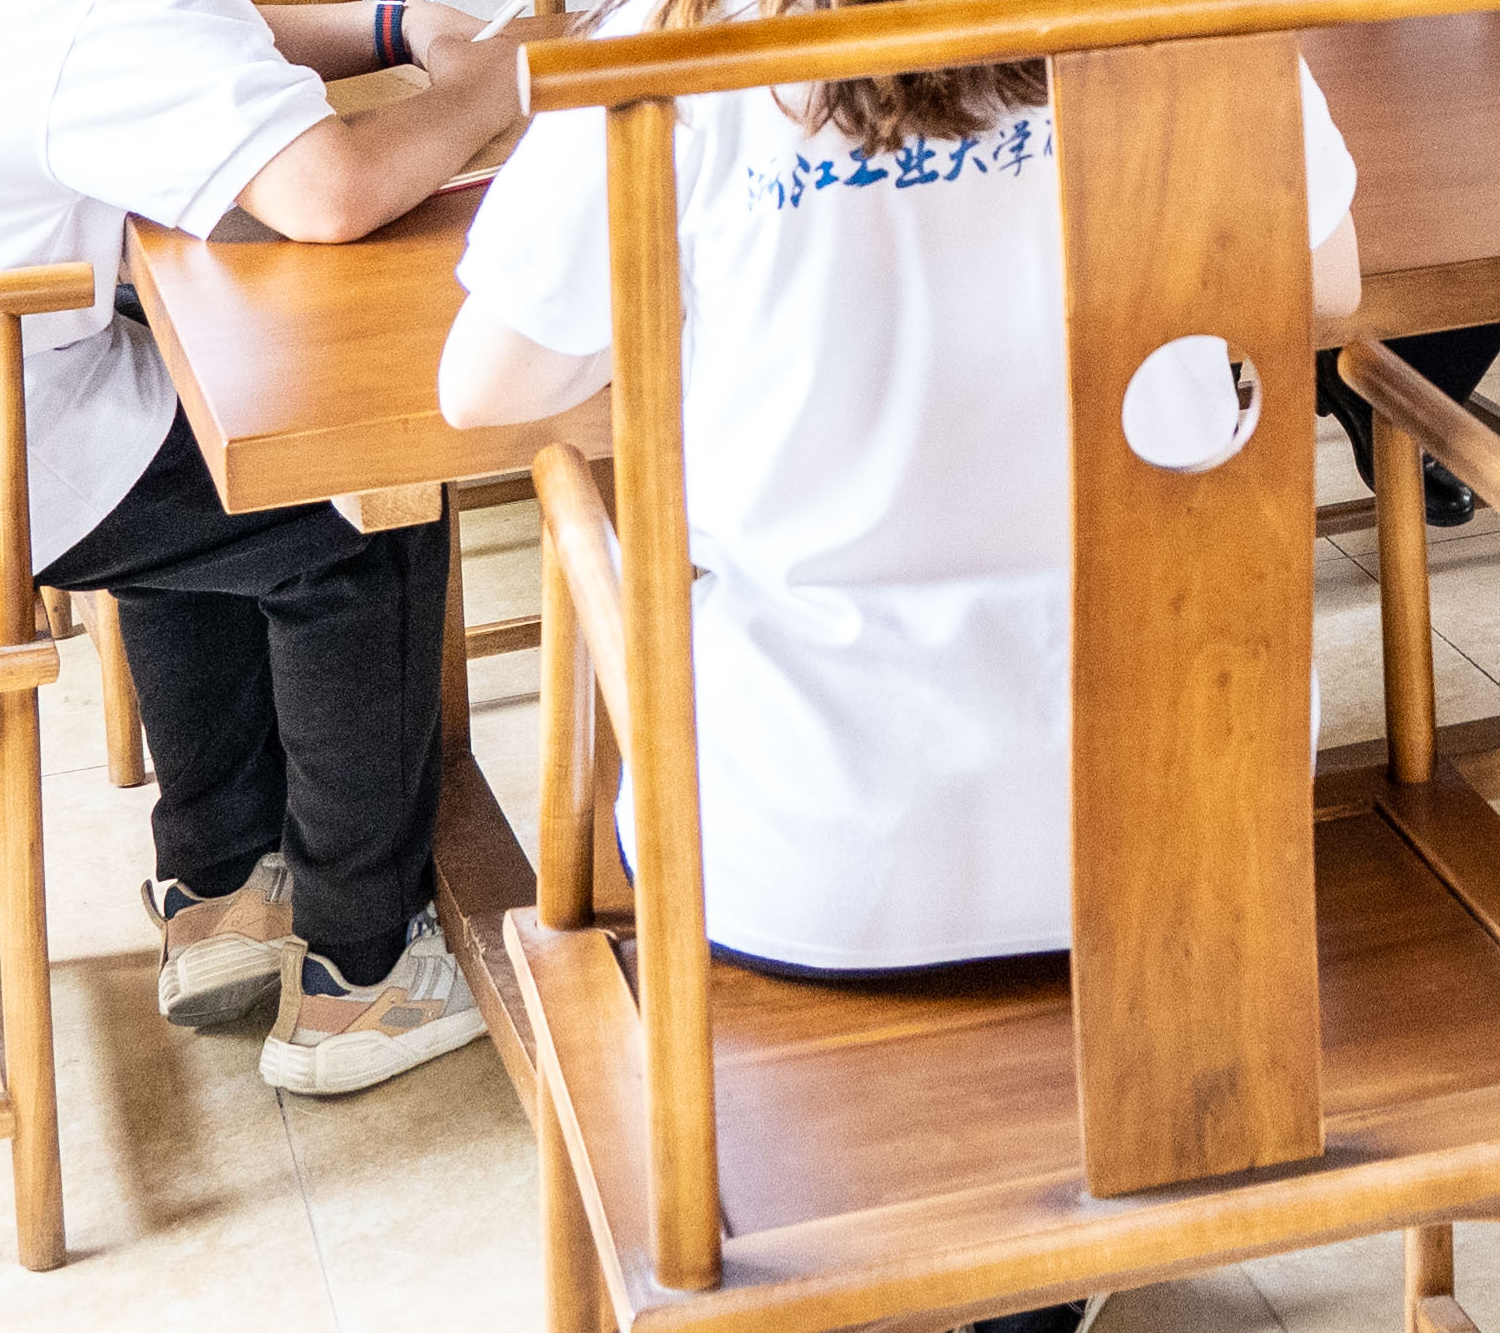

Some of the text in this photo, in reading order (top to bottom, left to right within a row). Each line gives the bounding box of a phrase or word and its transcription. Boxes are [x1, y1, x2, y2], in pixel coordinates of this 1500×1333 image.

[747, 119, 1056, 211] 浙江工业大学
